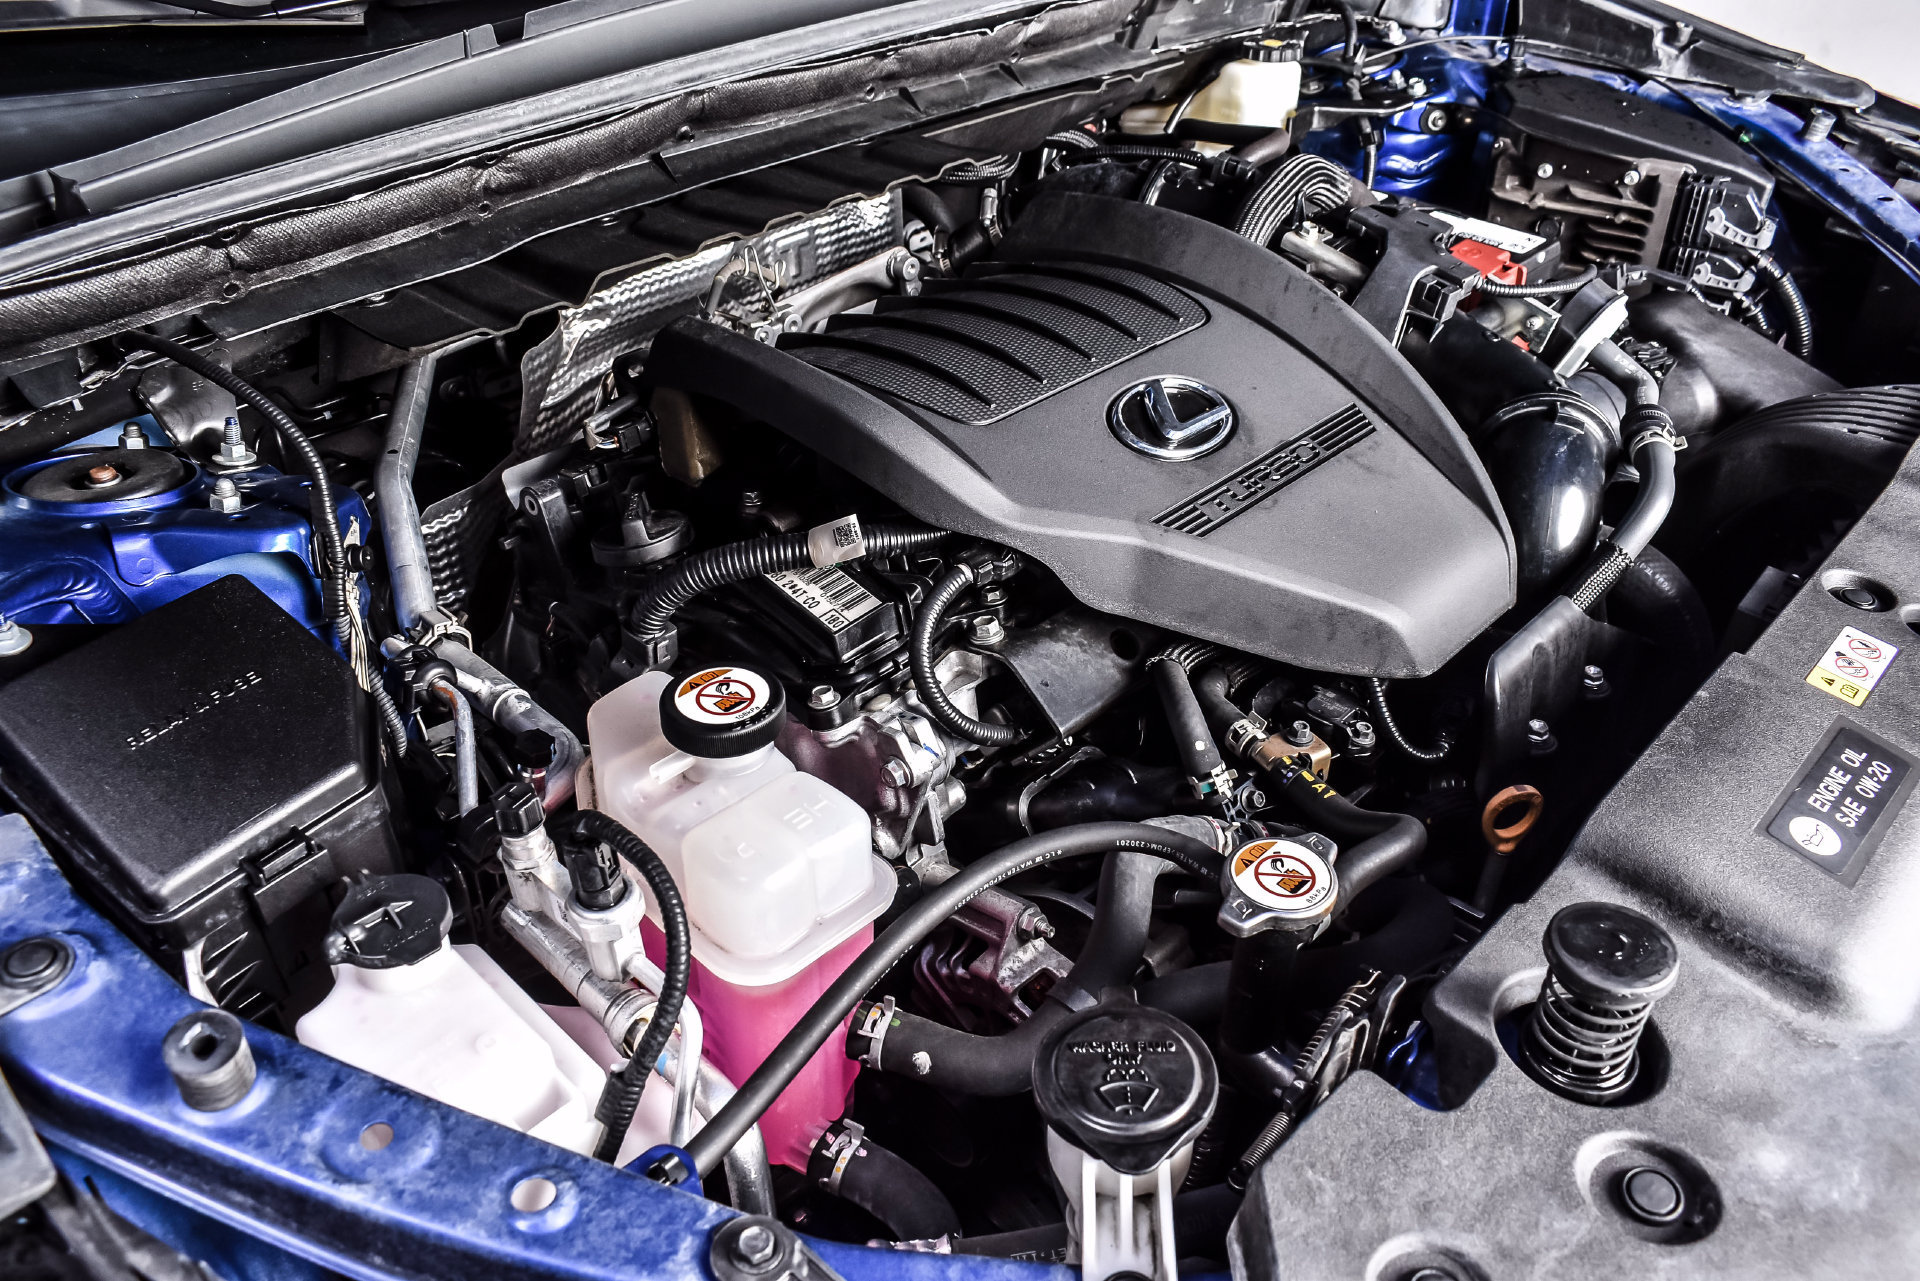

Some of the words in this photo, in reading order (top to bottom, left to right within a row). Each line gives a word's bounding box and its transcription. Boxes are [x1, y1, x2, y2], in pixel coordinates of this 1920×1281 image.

[1197, 440, 1321, 512] TURBO
[825, 613, 845, 629] 180
[1808, 766, 1853, 814] ENGINE
[1840, 748, 1868, 768] OIL
[1835, 797, 1868, 828] SAE
[1854, 760, 1893, 799] 0W-20
[1070, 1041, 1129, 1053] WASHER
[1137, 1041, 1176, 1053] FLUID
